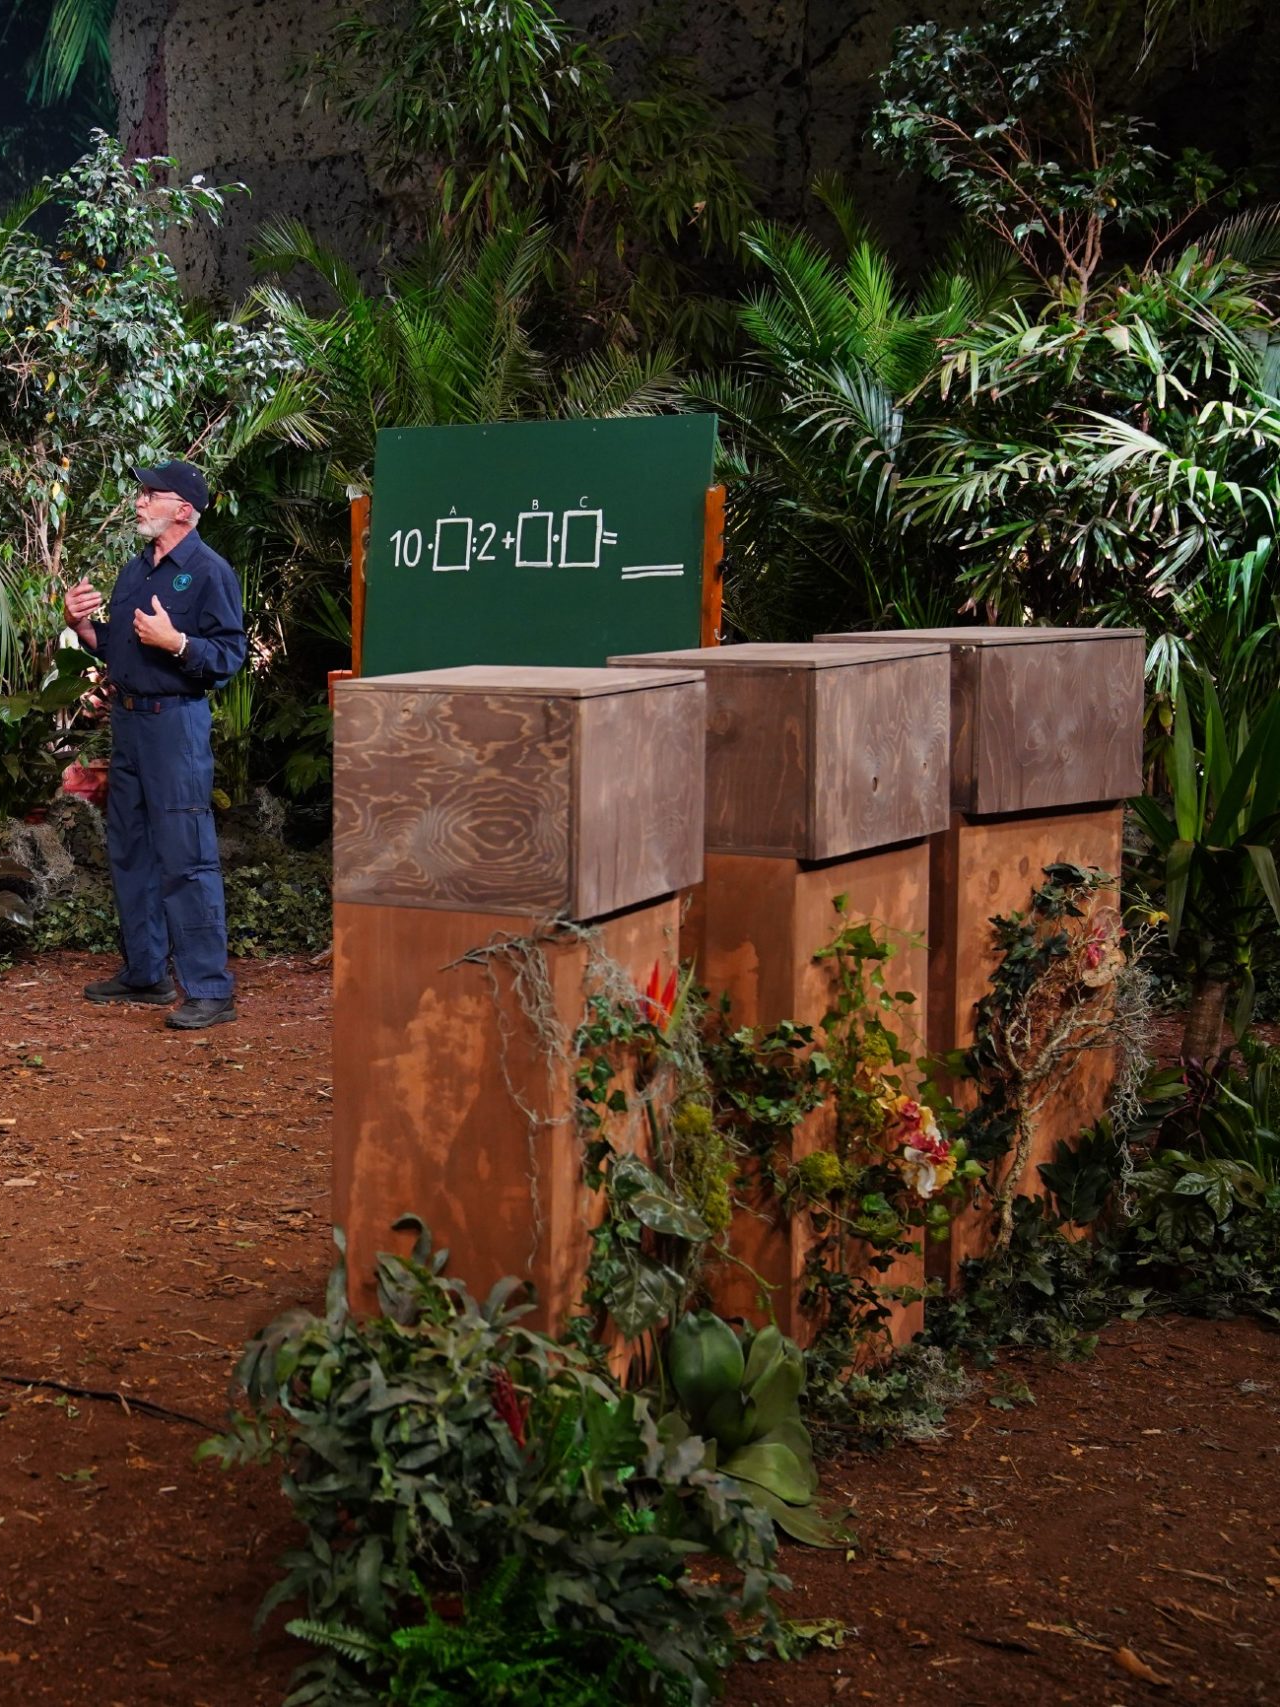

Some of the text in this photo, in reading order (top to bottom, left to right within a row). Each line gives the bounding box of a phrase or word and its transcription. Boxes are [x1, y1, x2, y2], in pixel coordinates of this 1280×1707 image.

[531, 499, 539, 511] B
[579, 495, 589, 508] C
[449, 505, 457, 516] A
